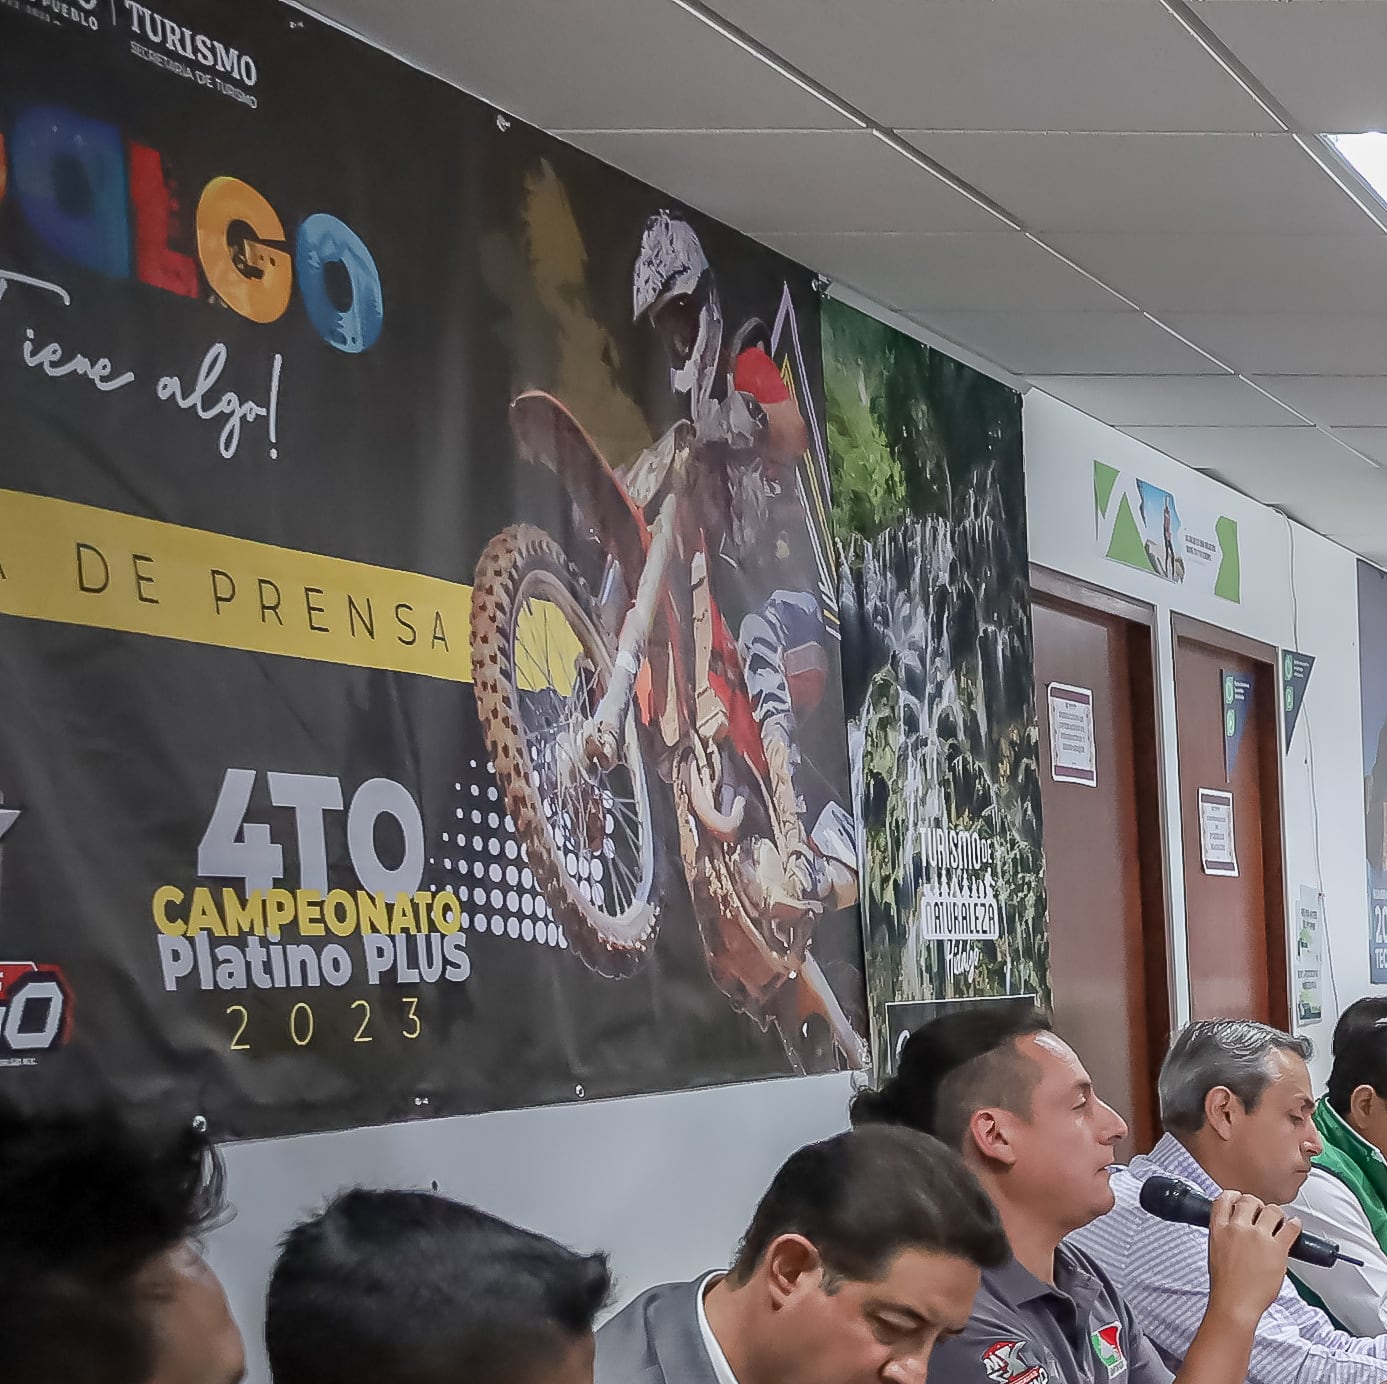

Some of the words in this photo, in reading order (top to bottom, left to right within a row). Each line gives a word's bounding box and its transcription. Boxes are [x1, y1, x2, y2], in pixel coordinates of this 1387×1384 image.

[124, 0, 257, 86] TURISMO
[157, 342, 283, 459] algo!
[74, 541, 160, 605] DE
[210, 568, 450, 653] PRENSA
[197, 767, 426, 903] 4TO
[920, 828, 982, 871] TURISMO
[152, 884, 462, 938] CAMPEONATO
[925, 901, 996, 935] NATURALEZA
[157, 931, 354, 992] Platino
[361, 932, 472, 986] PLUS
[226, 997, 422, 1050] 2023
